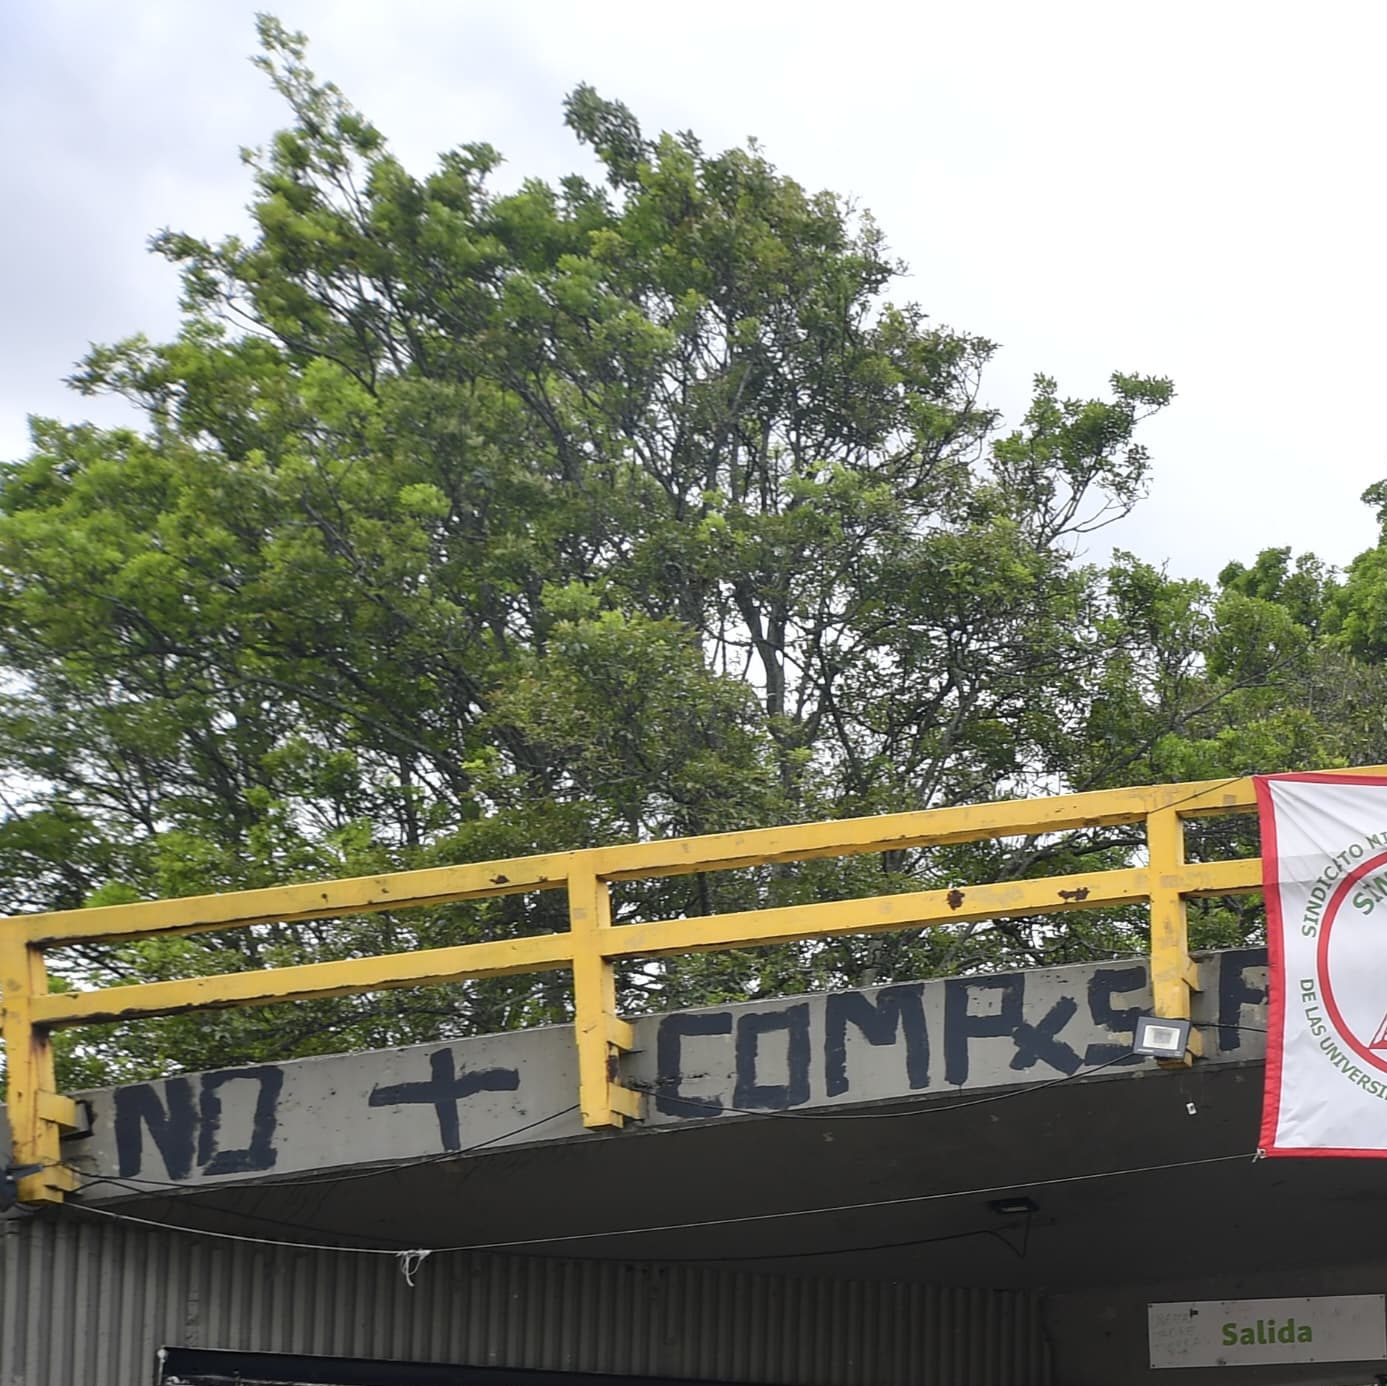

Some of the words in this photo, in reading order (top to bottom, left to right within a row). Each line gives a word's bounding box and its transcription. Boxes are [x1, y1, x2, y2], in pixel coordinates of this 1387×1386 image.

[1301, 843, 1364, 938] SINDICATO
[1299, 978, 1317, 1003] DE
[1304, 1006, 1327, 1037] LAS
[114, 1064, 285, 1181] NO
[1221, 1317, 1314, 1347] Salida
